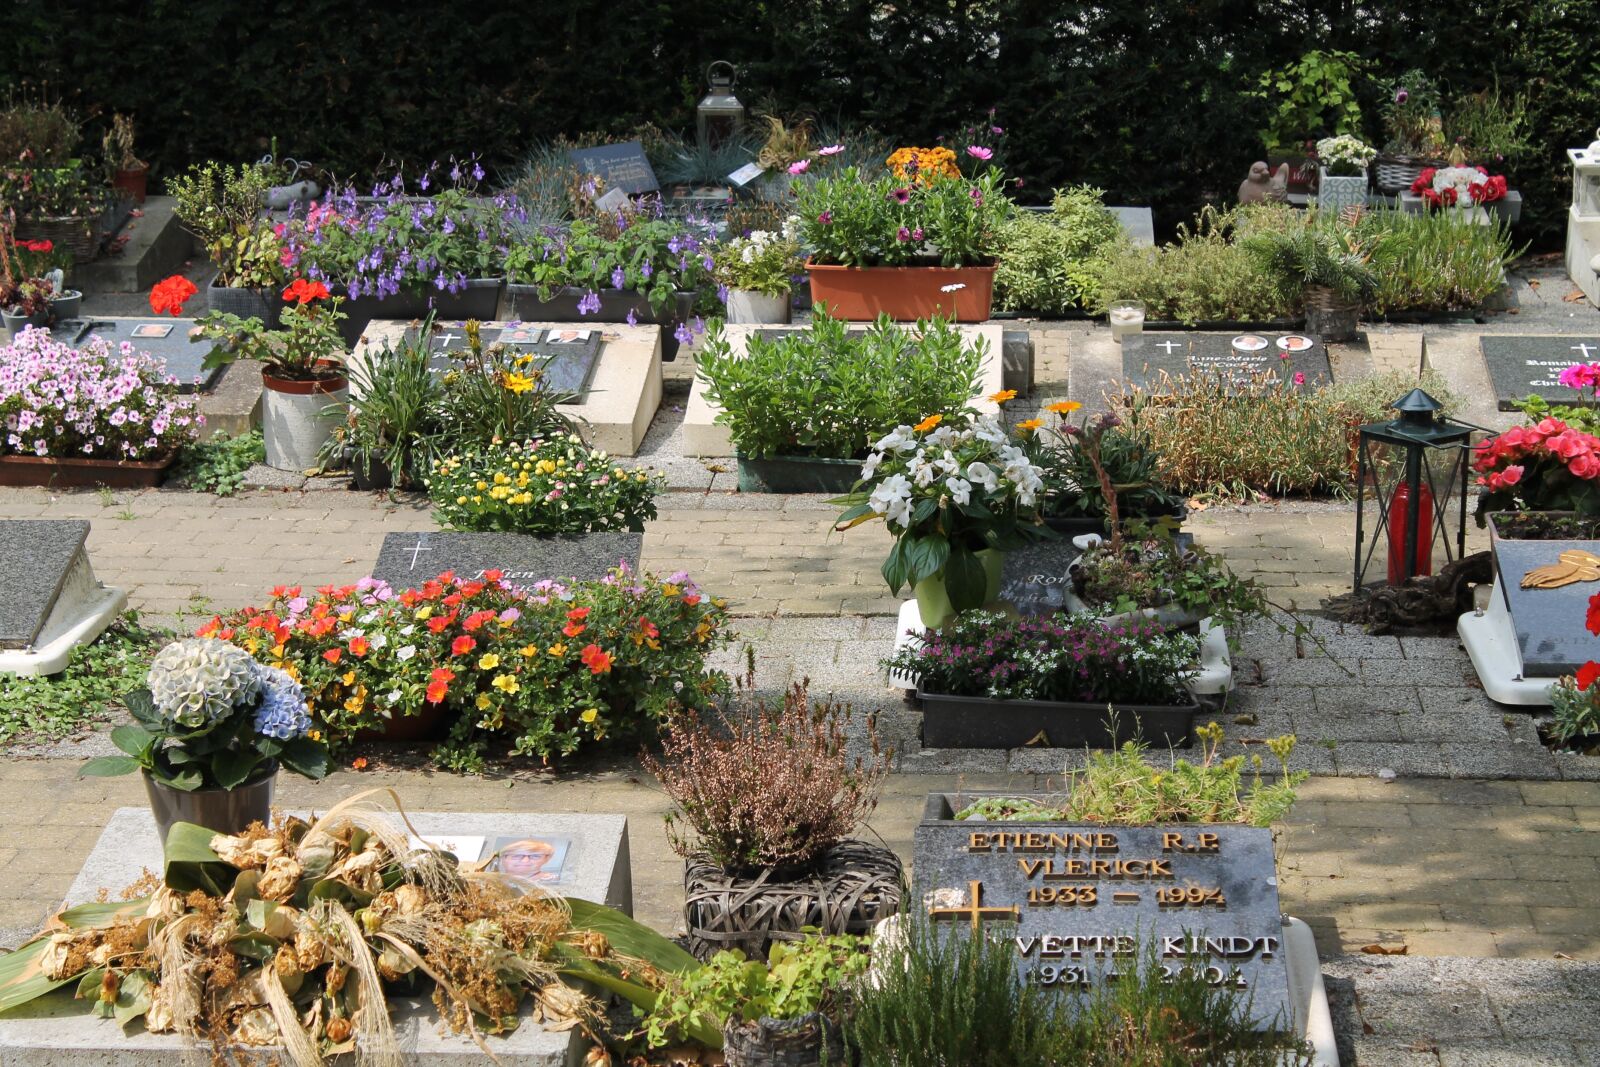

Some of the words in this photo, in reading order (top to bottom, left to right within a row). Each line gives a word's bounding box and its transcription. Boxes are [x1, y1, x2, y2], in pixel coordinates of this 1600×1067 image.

[968, 832, 1118, 851] ETIENNE
[1162, 832, 1220, 851] R.P.
[1017, 858, 1175, 877] VLERICK
[1027, 886, 1098, 905] 1933
[1155, 885, 1226, 905] 1994
[1162, 936, 1278, 956] KINDT
